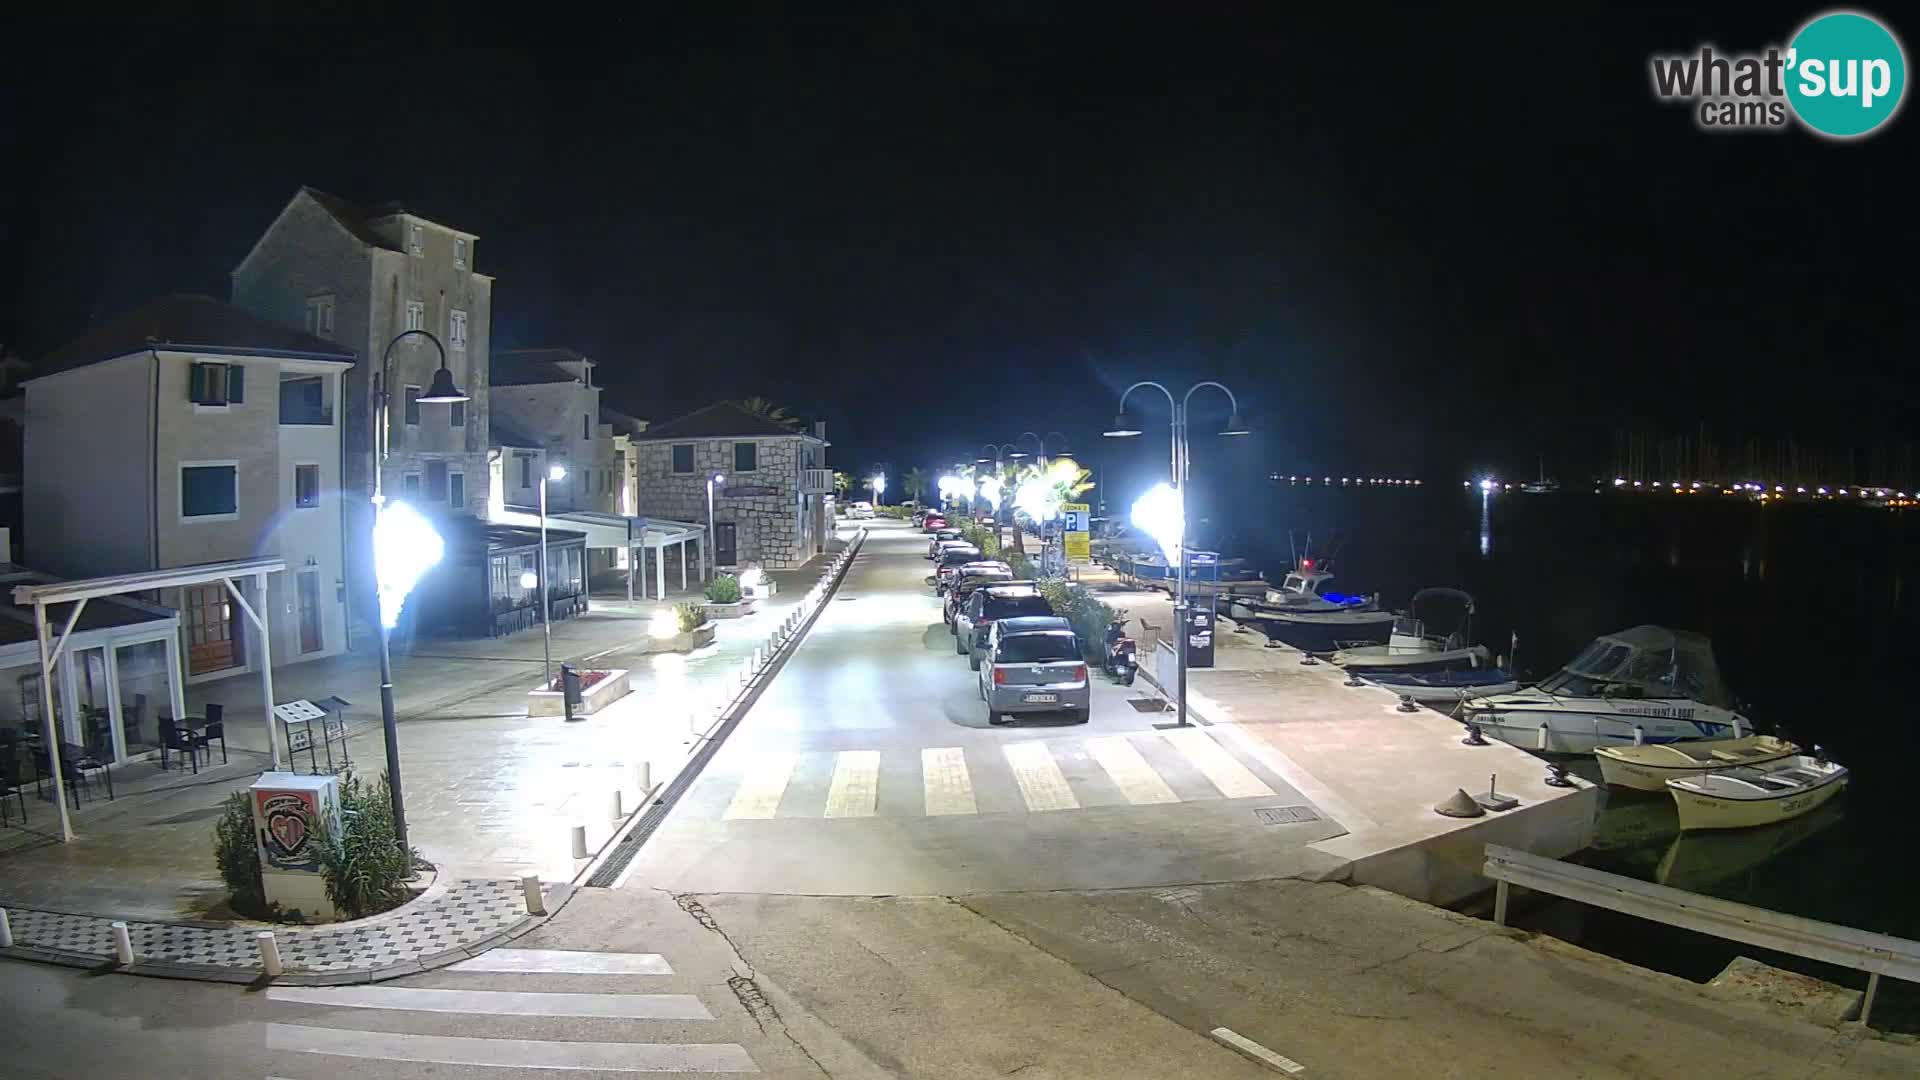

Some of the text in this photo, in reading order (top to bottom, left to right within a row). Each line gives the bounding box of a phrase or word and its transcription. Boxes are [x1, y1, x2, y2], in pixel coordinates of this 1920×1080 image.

[1066, 513, 1077, 530] P
[1652, 707, 1670, 718] RENT
[1678, 708, 1696, 720] BOAT
